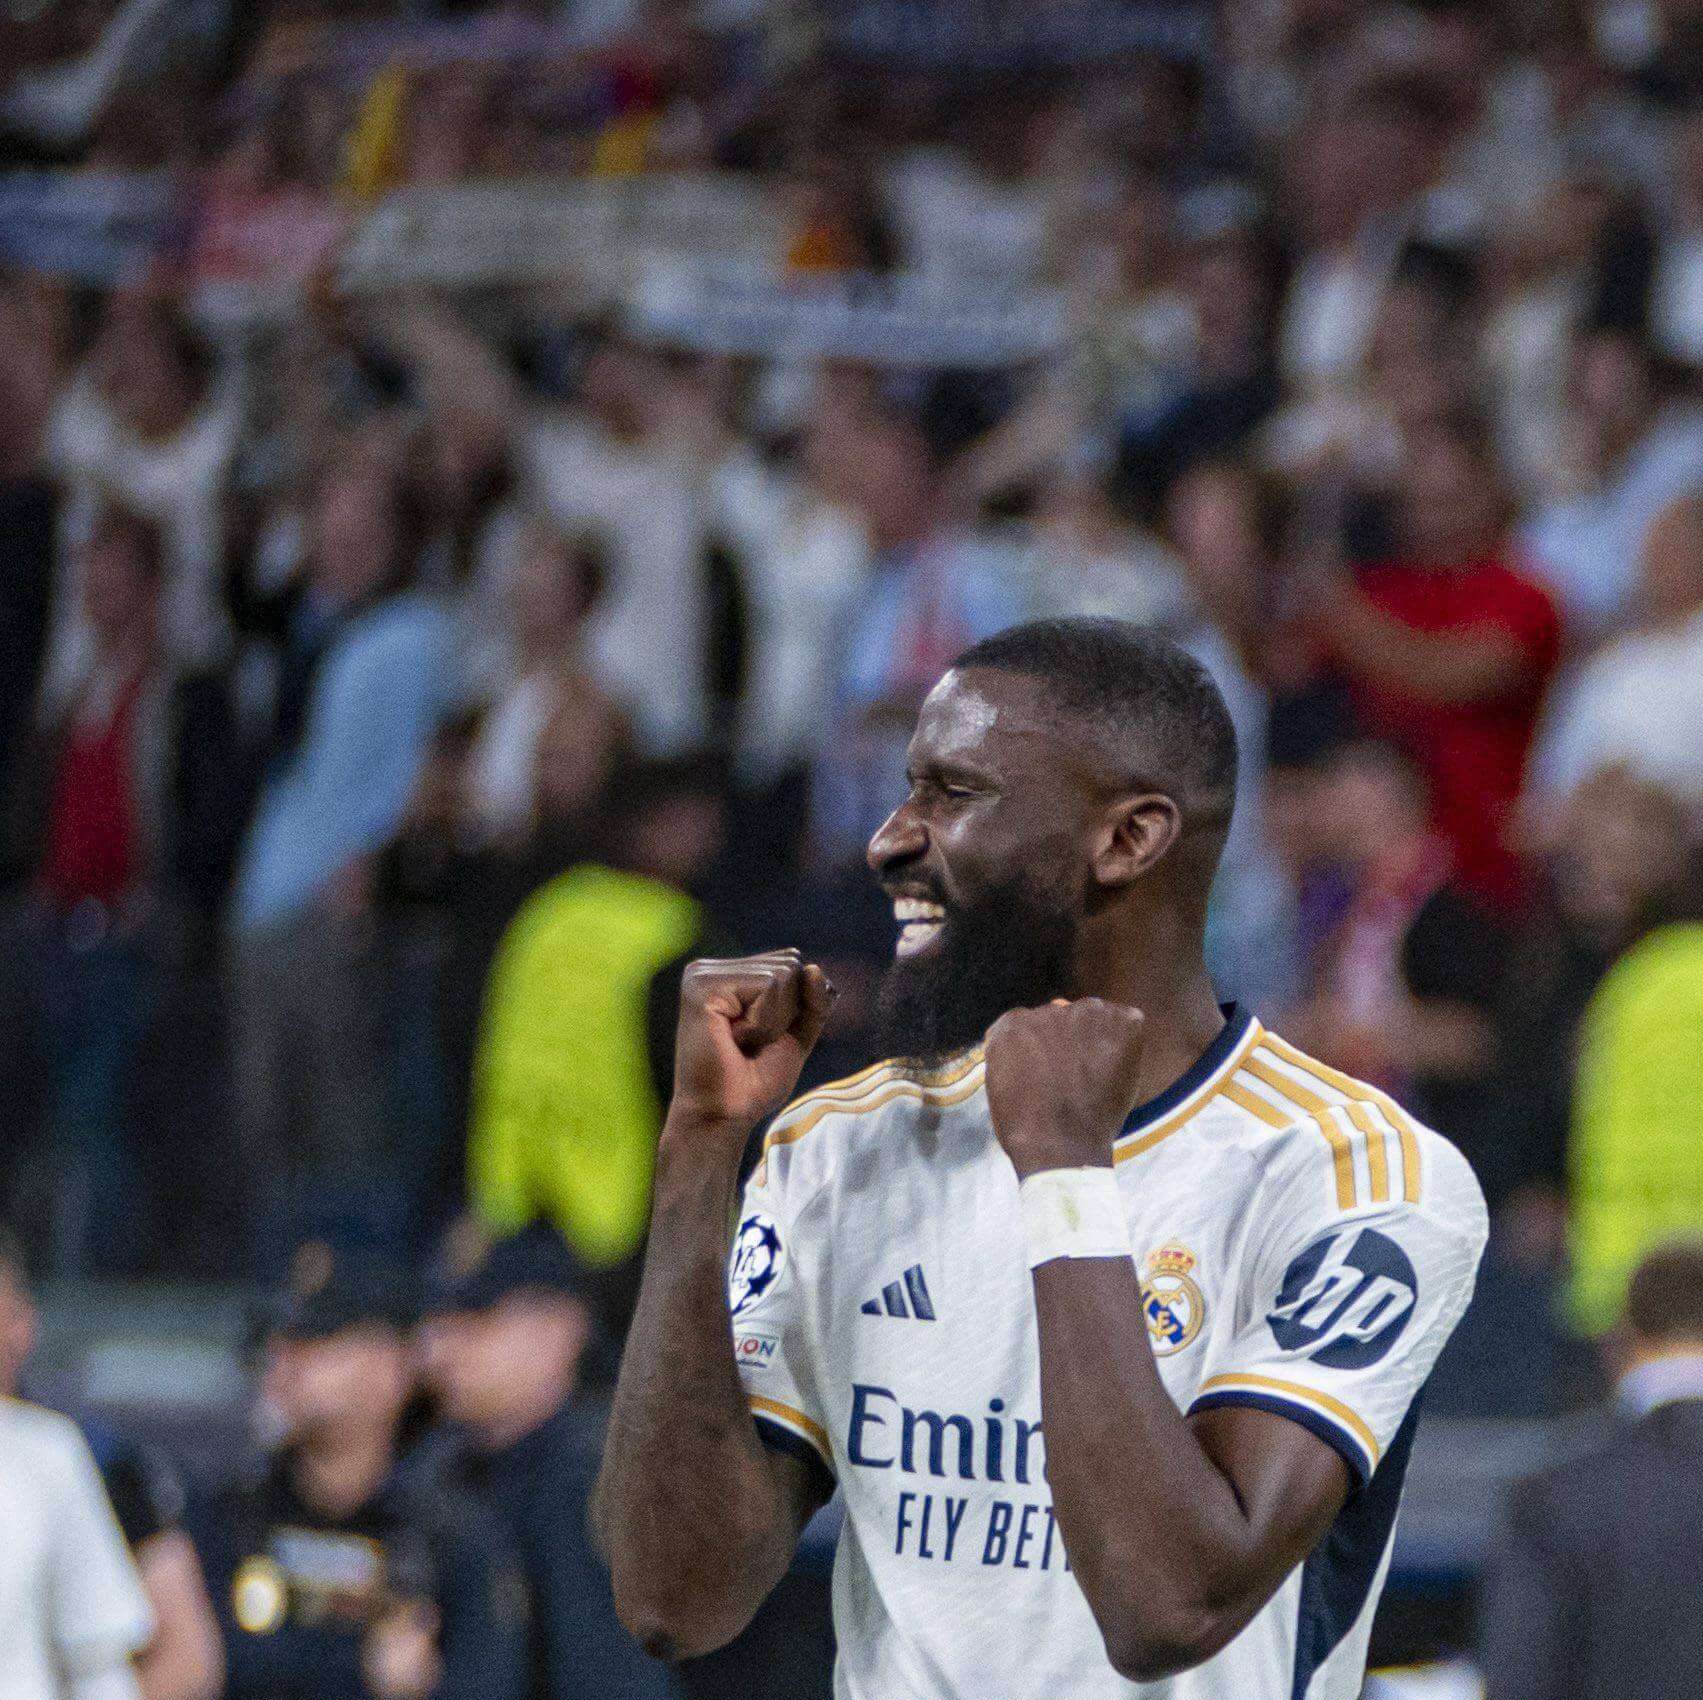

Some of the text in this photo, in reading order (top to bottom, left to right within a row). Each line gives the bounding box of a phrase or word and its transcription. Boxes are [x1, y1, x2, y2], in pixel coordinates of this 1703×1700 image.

[1266, 1227, 1419, 1370] hp
[848, 1383, 1050, 1484] Emir
[895, 1492, 1073, 1572] FLY BET
